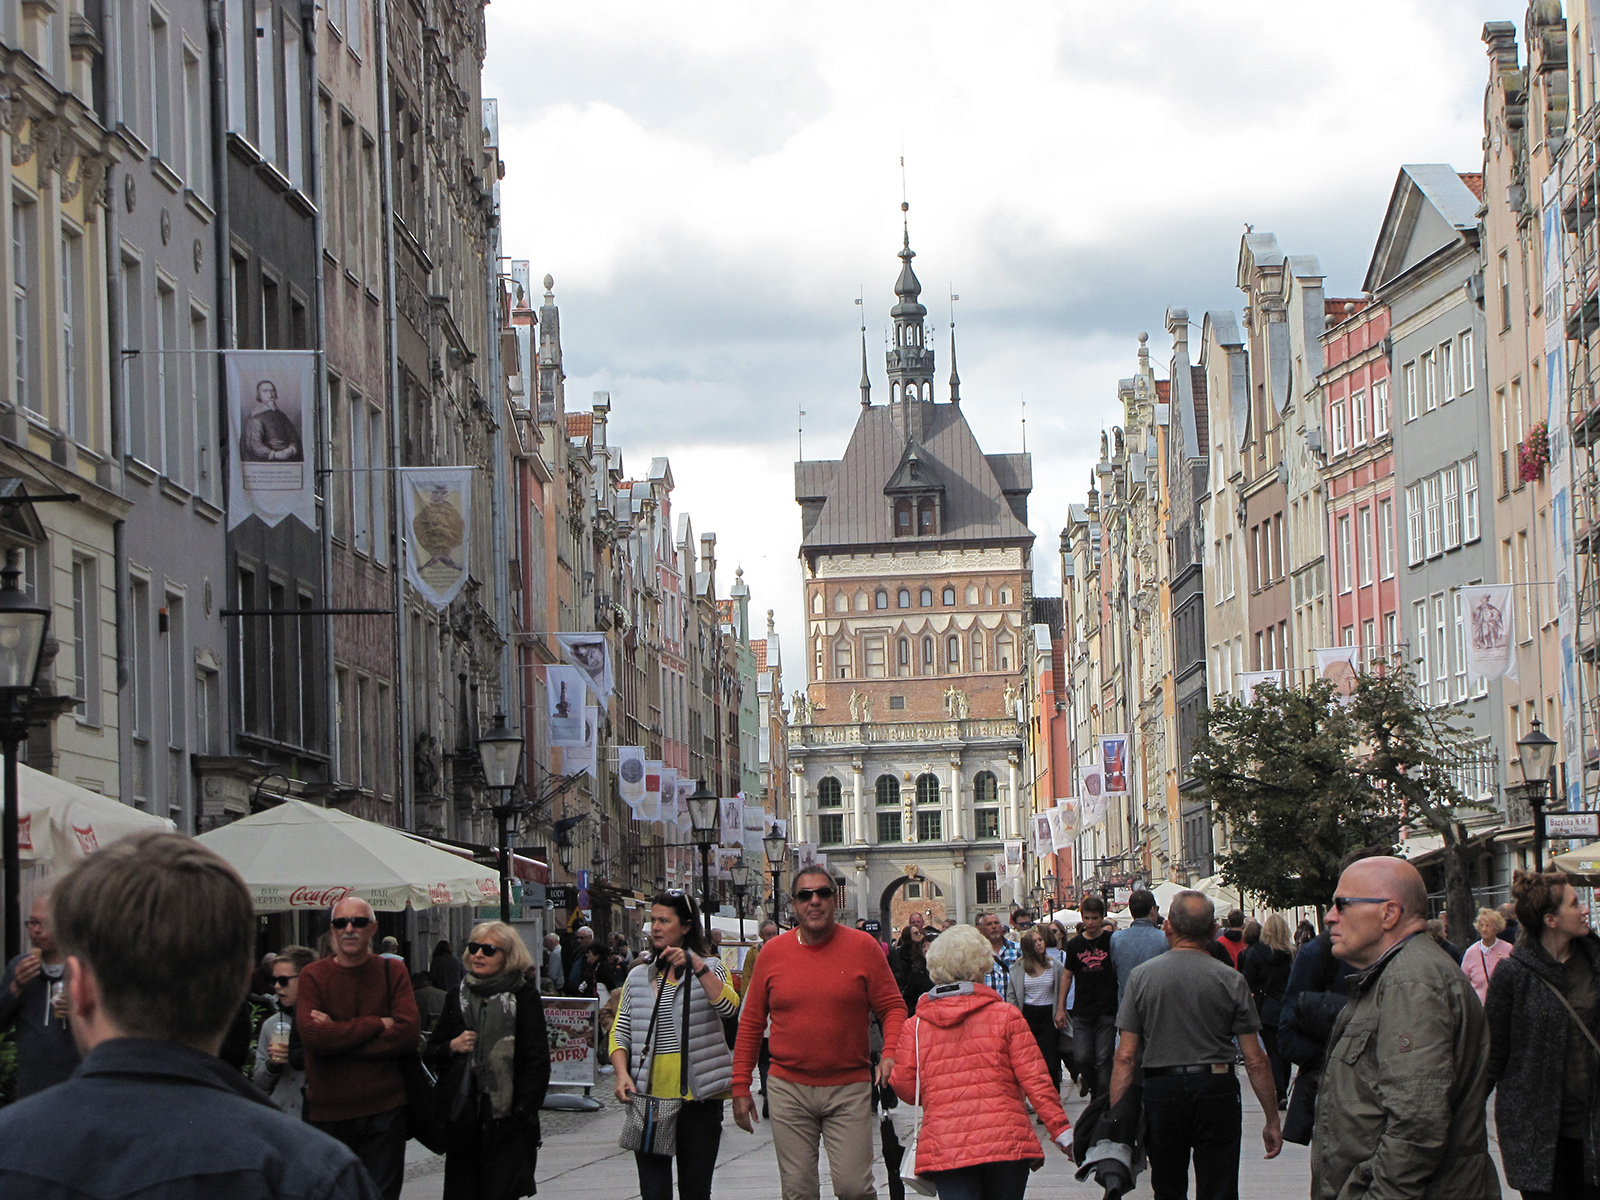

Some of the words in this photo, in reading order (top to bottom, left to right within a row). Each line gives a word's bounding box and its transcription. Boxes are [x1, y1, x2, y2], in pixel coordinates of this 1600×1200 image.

[289, 885, 357, 907] Coca-Col
[371, 889, 388, 898] BAR
[366, 898, 396, 907] EPTUN
[567, 1038, 586, 1046] MEGA
